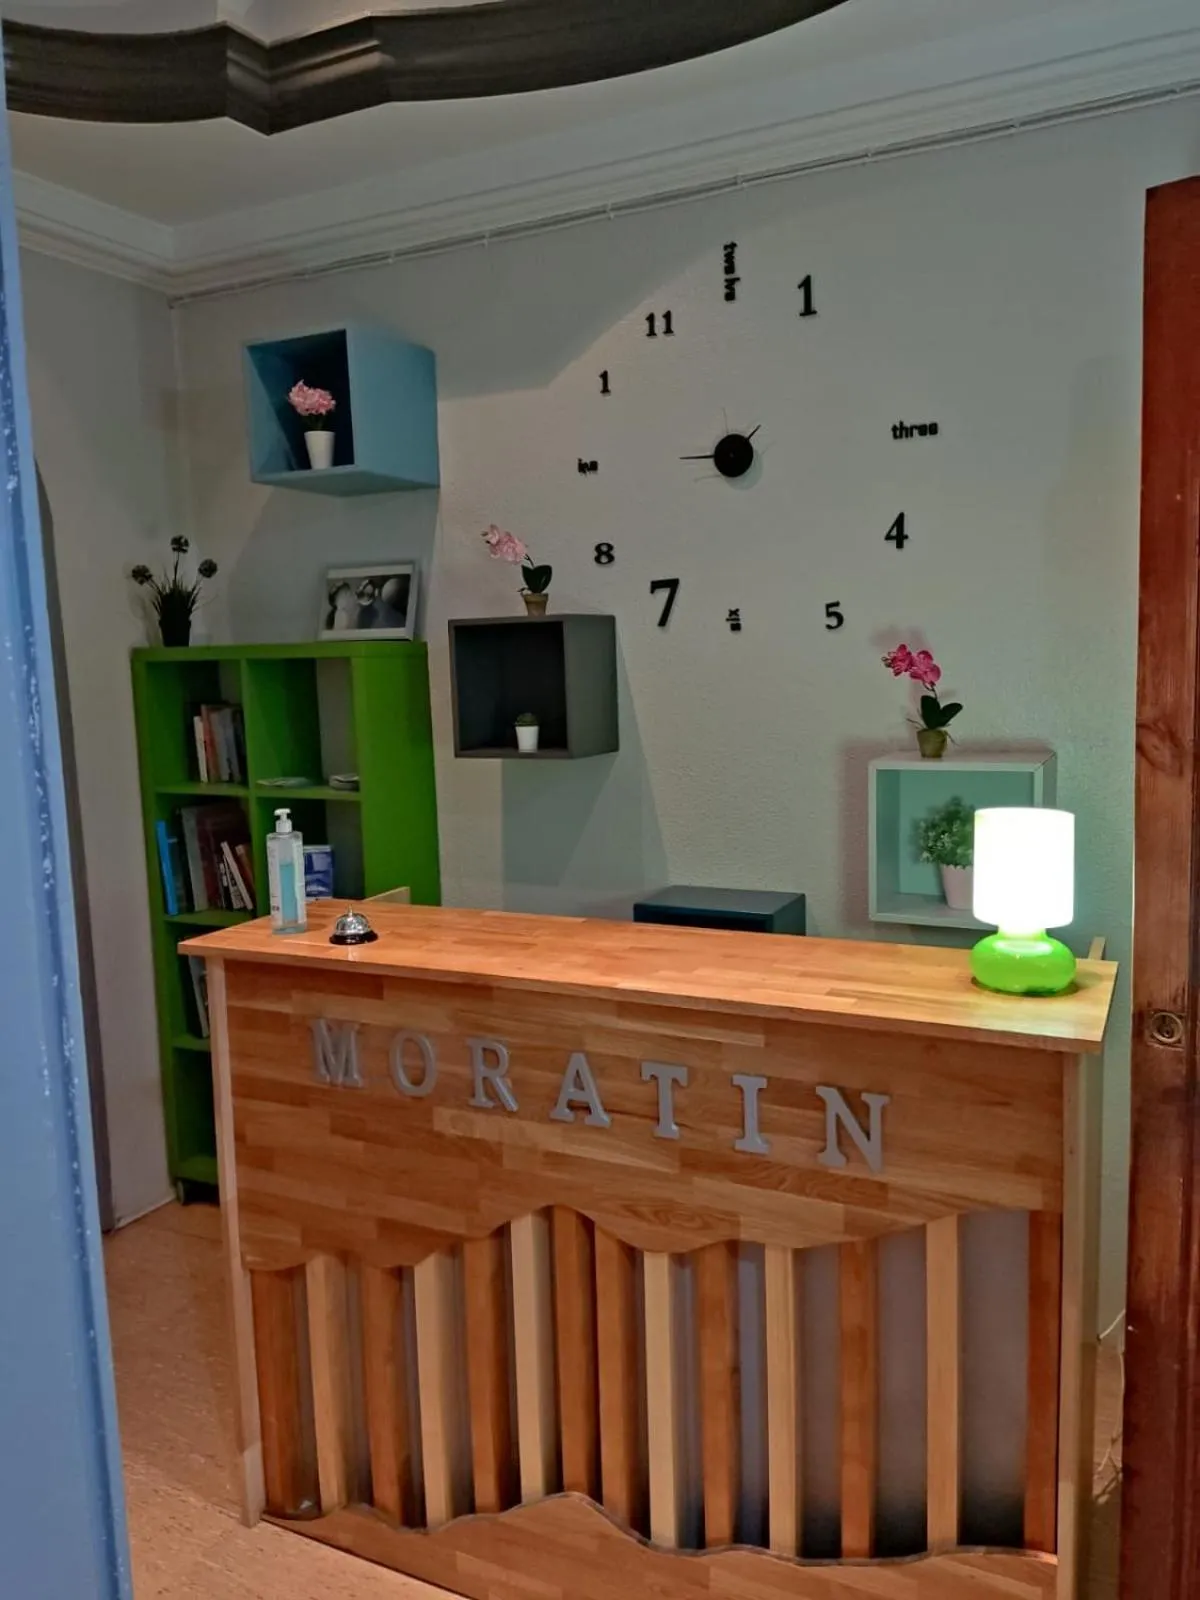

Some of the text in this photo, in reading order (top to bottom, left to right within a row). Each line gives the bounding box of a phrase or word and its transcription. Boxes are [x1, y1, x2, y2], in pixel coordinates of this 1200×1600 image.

[797, 274, 818, 318] 1
[644, 309, 675, 338] 11
[598, 369, 611, 395] 1
[890, 419, 939, 441] three
[884, 511, 909, 550] 4
[593, 542, 616, 566] 8
[649, 577, 680, 628] 7
[824, 600, 845, 631] 5
[310, 1017, 891, 1174] MORATIN
